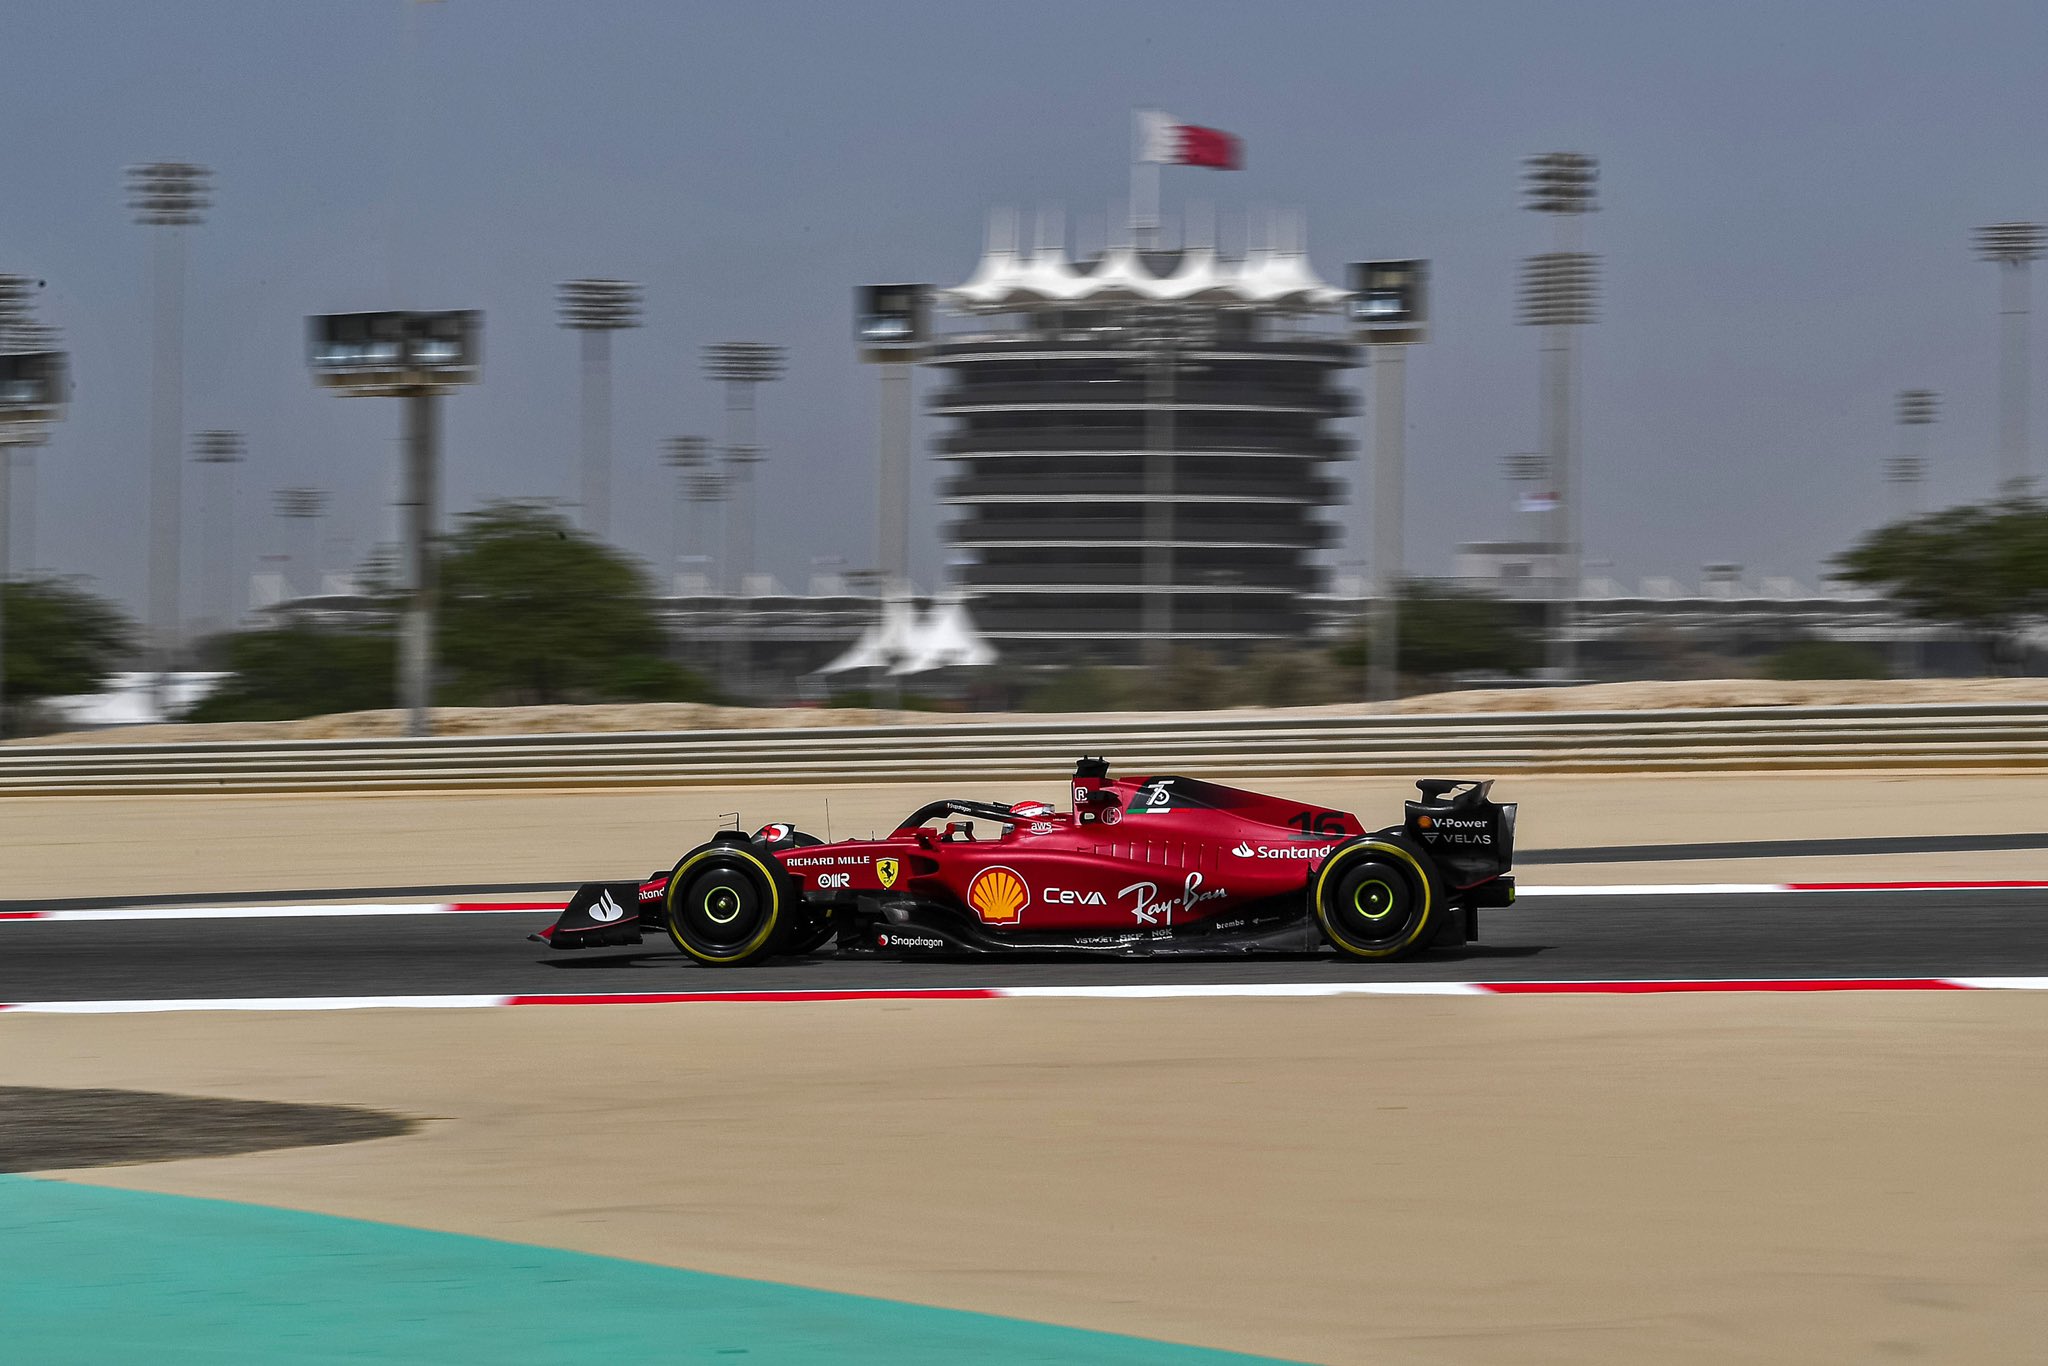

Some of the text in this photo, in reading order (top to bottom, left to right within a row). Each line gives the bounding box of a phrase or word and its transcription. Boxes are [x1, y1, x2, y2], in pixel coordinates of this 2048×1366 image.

[1031, 821, 1052, 831] aws
[1287, 811, 1345, 841] 16
[1432, 818, 1488, 828] V-Power
[1443, 834, 1492, 845] VELAS
[786, 855, 870, 867] RICHARD MILLE
[1216, 919, 1245, 930] brembo
[1151, 928, 1173, 937] NGK
[890, 934, 944, 949] Snapdragon
